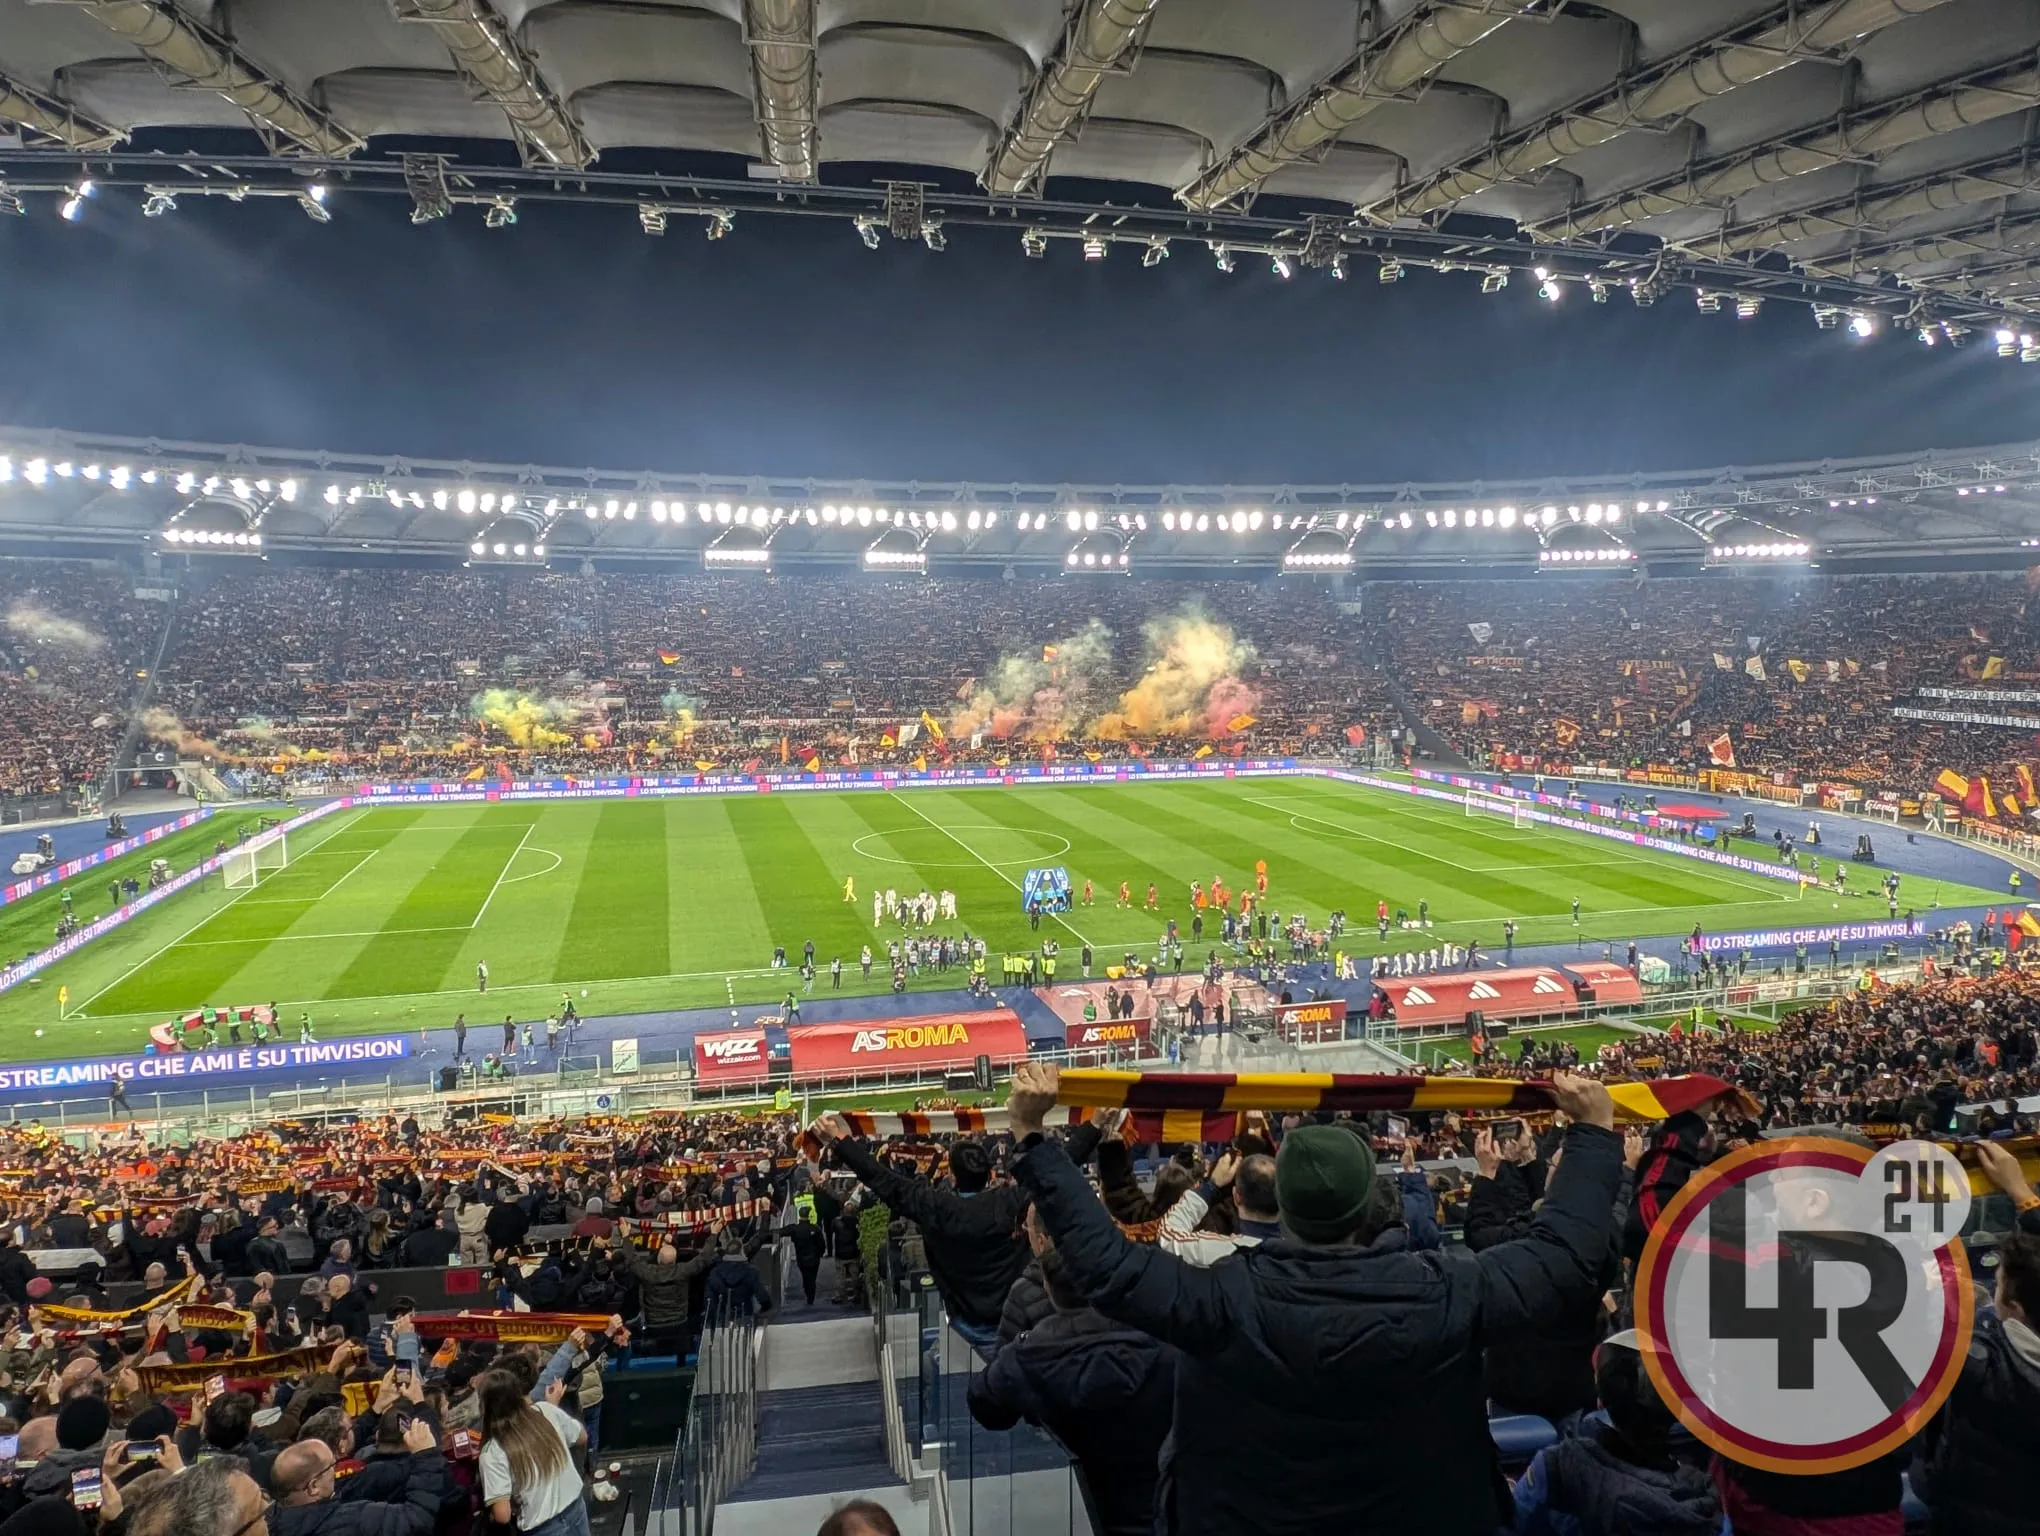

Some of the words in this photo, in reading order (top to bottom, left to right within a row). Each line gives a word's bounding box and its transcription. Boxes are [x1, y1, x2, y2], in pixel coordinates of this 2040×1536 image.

[371, 785, 391, 794] TIM
[1600, 805, 1616, 818] TIM
[1644, 837, 1654, 846] LO
[1655, 838, 1698, 857] STREAMING
[1699, 849, 1714, 860] CHE
[1716, 853, 1732, 865] AMI
[1733, 856, 1738, 867] È
[1740, 858, 1751, 870] SU
[1754, 862, 1798, 880] TIMVISION
[66, 860, 81, 876] TIM
[15, 879, 32, 897] TIM
[1706, 937, 1722, 950] LO
[1724, 932, 1790, 949] STREAMING
[1793, 931, 1814, 944] CHE
[1815, 930, 1839, 942] AMI
[1842, 927, 1849, 940] È
[1850, 927, 1865, 939] SU
[1868, 922, 1922, 938] TIMVISIN
[0, 1062, 134, 1089] STREAMING
[138, 1057, 186, 1080] CHE
[189, 1053, 234, 1076] AMI
[238, 1048, 252, 1070] È
[256, 1048, 287, 1068] SU
[291, 1039, 403, 1064] TIMVISION
[717, 1054, 761, 1065] wizzair.com
